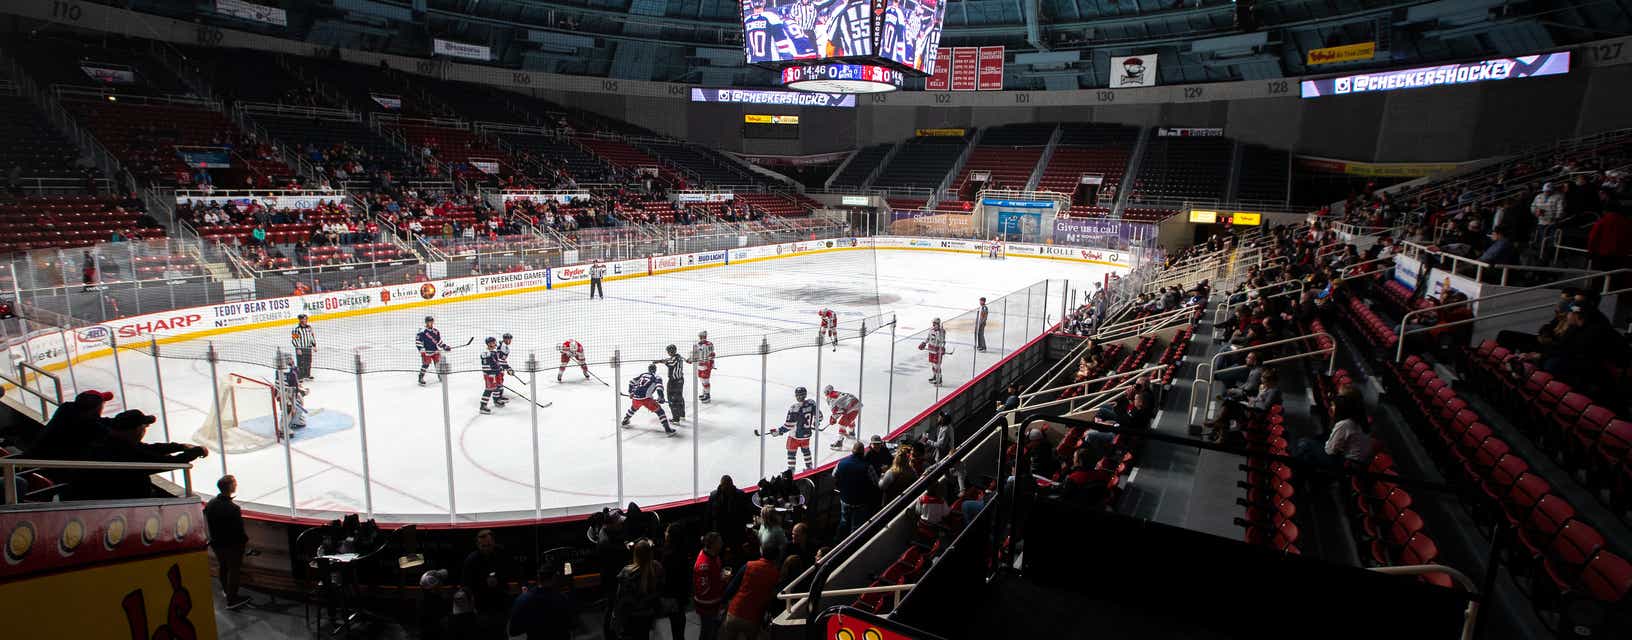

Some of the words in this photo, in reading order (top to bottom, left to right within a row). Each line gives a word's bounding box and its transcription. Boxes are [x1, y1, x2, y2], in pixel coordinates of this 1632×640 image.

[53, 1, 81, 21] 110
[851, 18, 871, 39] 55
[1592, 43, 1622, 60] 127
[802, 65, 826, 75] 14:46
[828, 66, 837, 78] 0
[1353, 61, 1516, 92] @CHECKERSHOCKEY
[1184, 87, 1202, 98] 129
[1267, 81, 1288, 95] 128
[935, 94, 951, 104] 102
[1015, 93, 1030, 104] 101
[1097, 91, 1114, 102] 130
[1057, 222, 1079, 232] Give
[1080, 225, 1092, 233] us
[1101, 224, 1118, 234] call
[710, 253, 725, 261] LIGHT
[490, 273, 522, 284] WEEKEND
[523, 271, 547, 280] GAMES
[564, 268, 585, 278] Ryder
[392, 287, 418, 298] chima
[214, 304, 242, 317] TEDDY
[244, 301, 267, 314] BEAR
[268, 299, 290, 311] TOSS
[118, 314, 202, 338] SHARP
